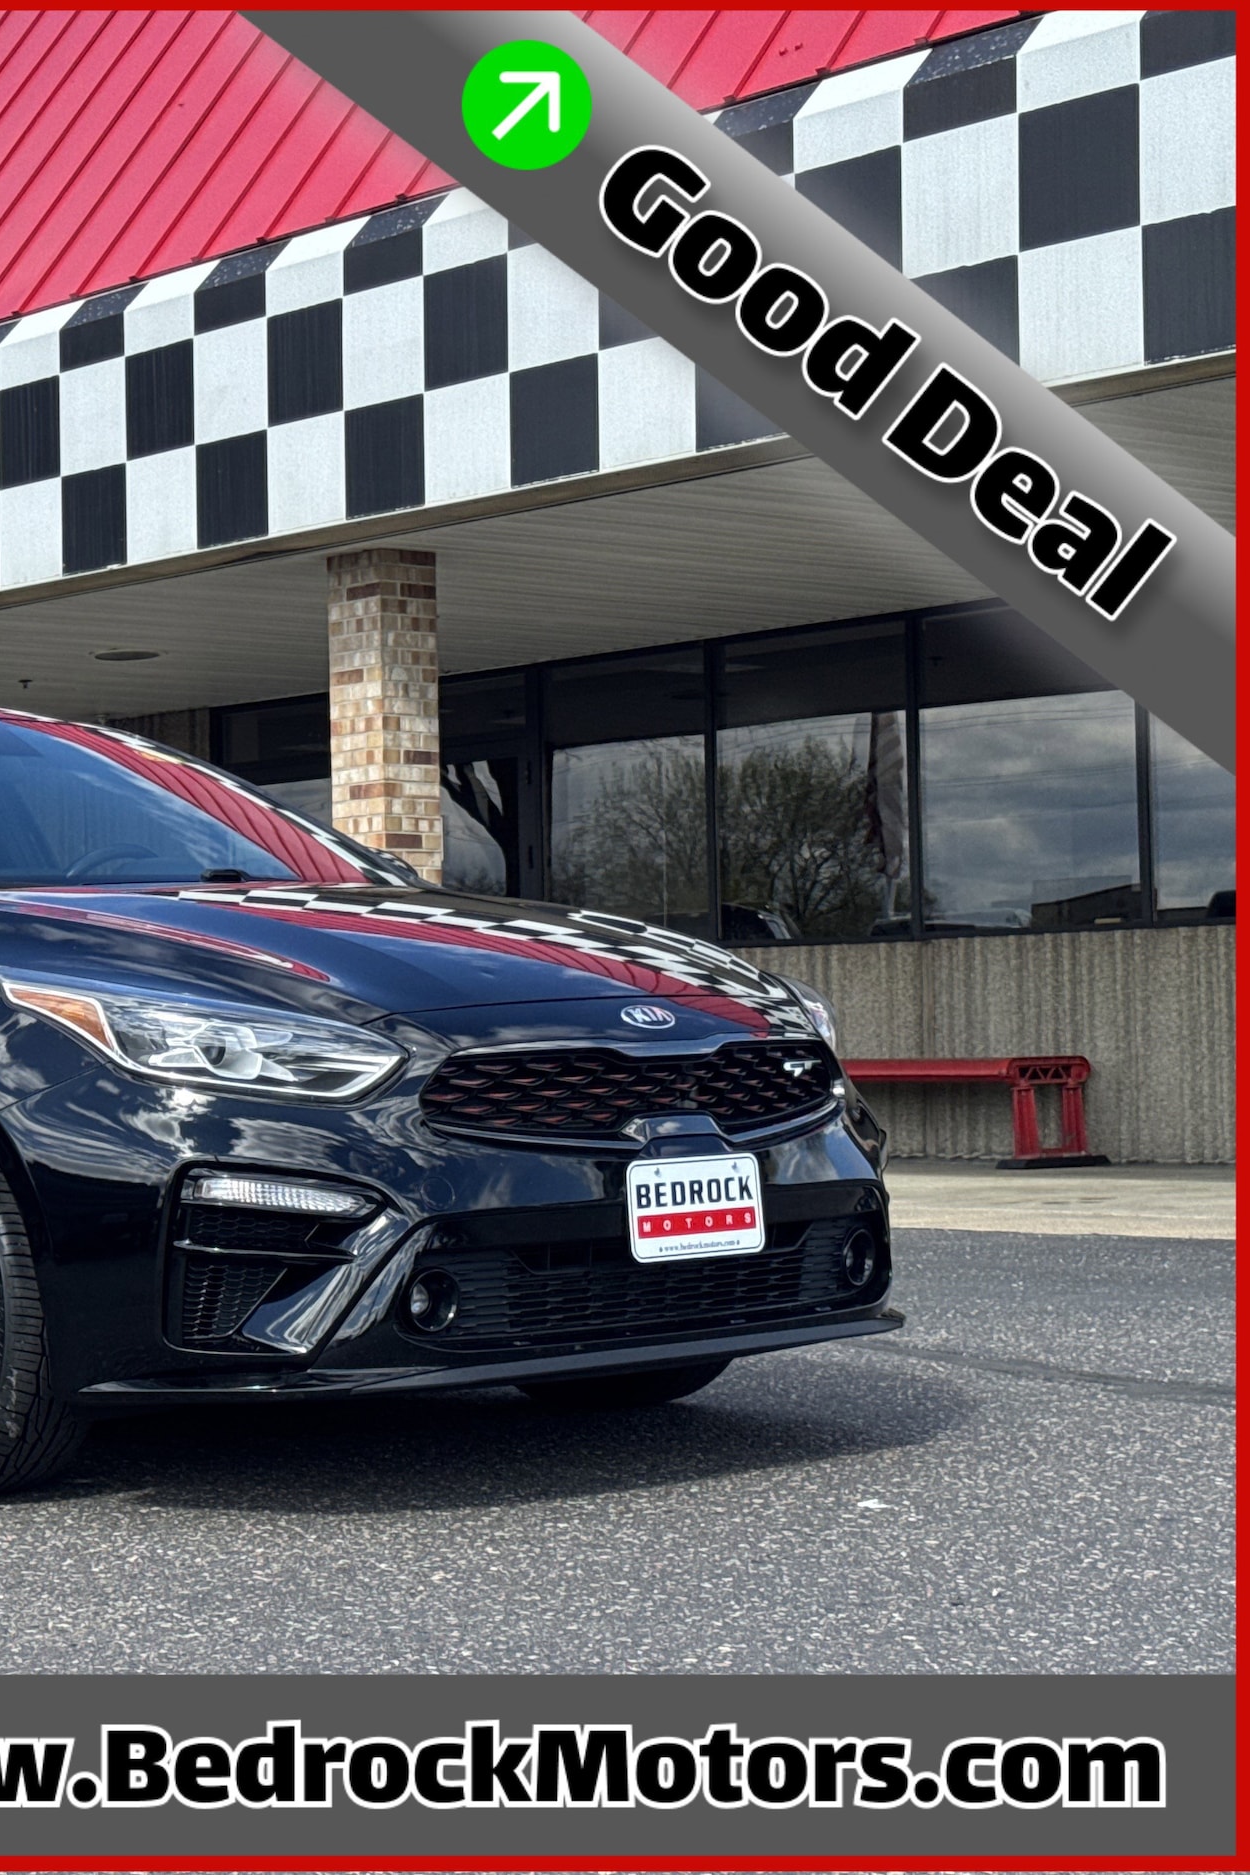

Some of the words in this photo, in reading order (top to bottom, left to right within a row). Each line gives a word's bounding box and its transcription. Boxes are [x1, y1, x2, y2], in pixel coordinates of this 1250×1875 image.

[629, 1006, 671, 1025] KIA
[636, 1176, 754, 1209] BEDROCK
[642, 1213, 752, 1233] MOTORS
